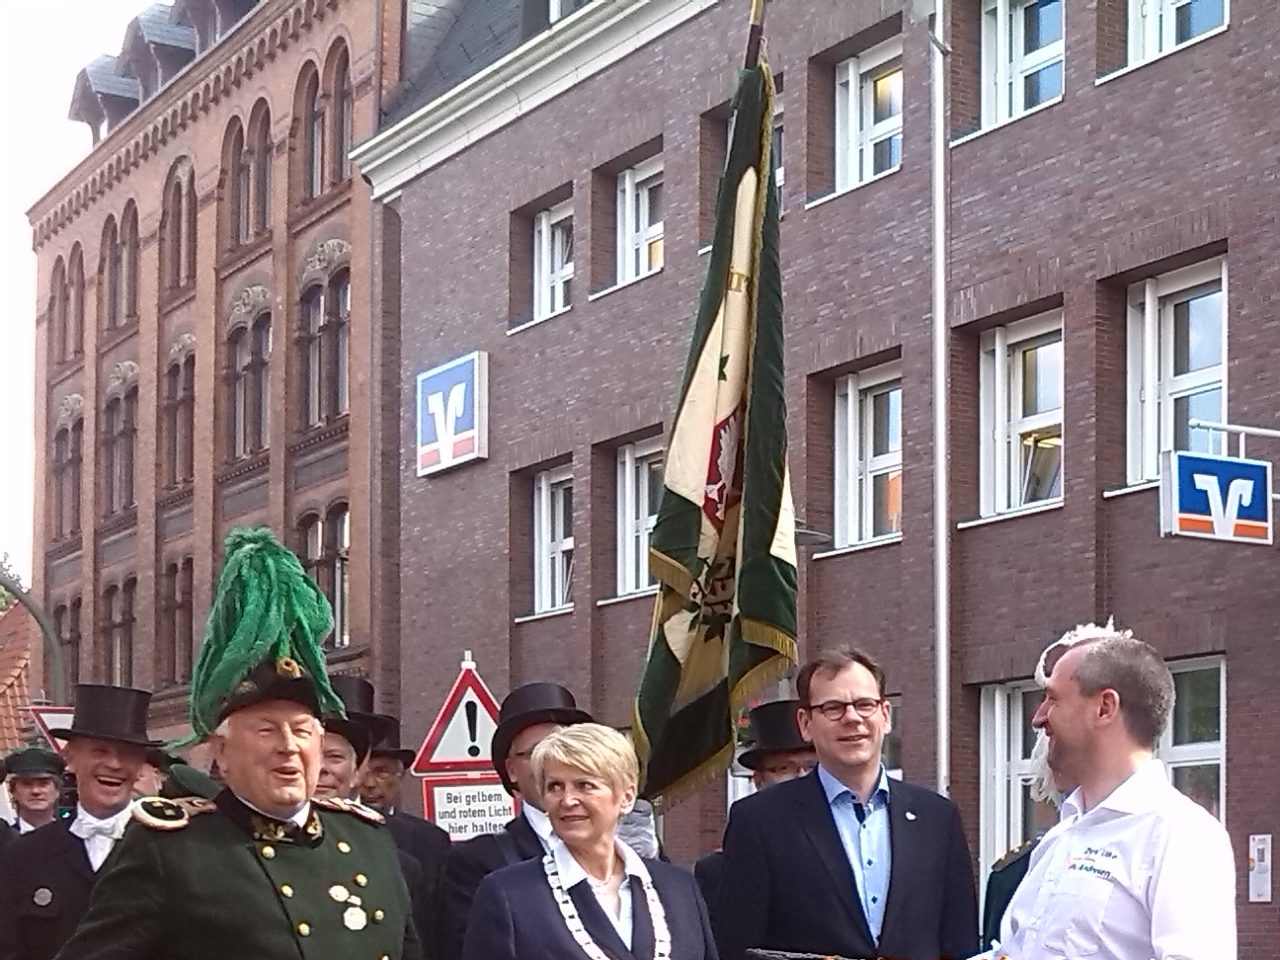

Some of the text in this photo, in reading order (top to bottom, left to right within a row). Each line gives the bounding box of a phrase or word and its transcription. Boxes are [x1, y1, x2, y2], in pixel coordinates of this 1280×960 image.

[446, 791, 503, 806] Bei gelbem
[438, 806, 512, 819] und rotem Licht
[448, 822, 468, 833] hier
